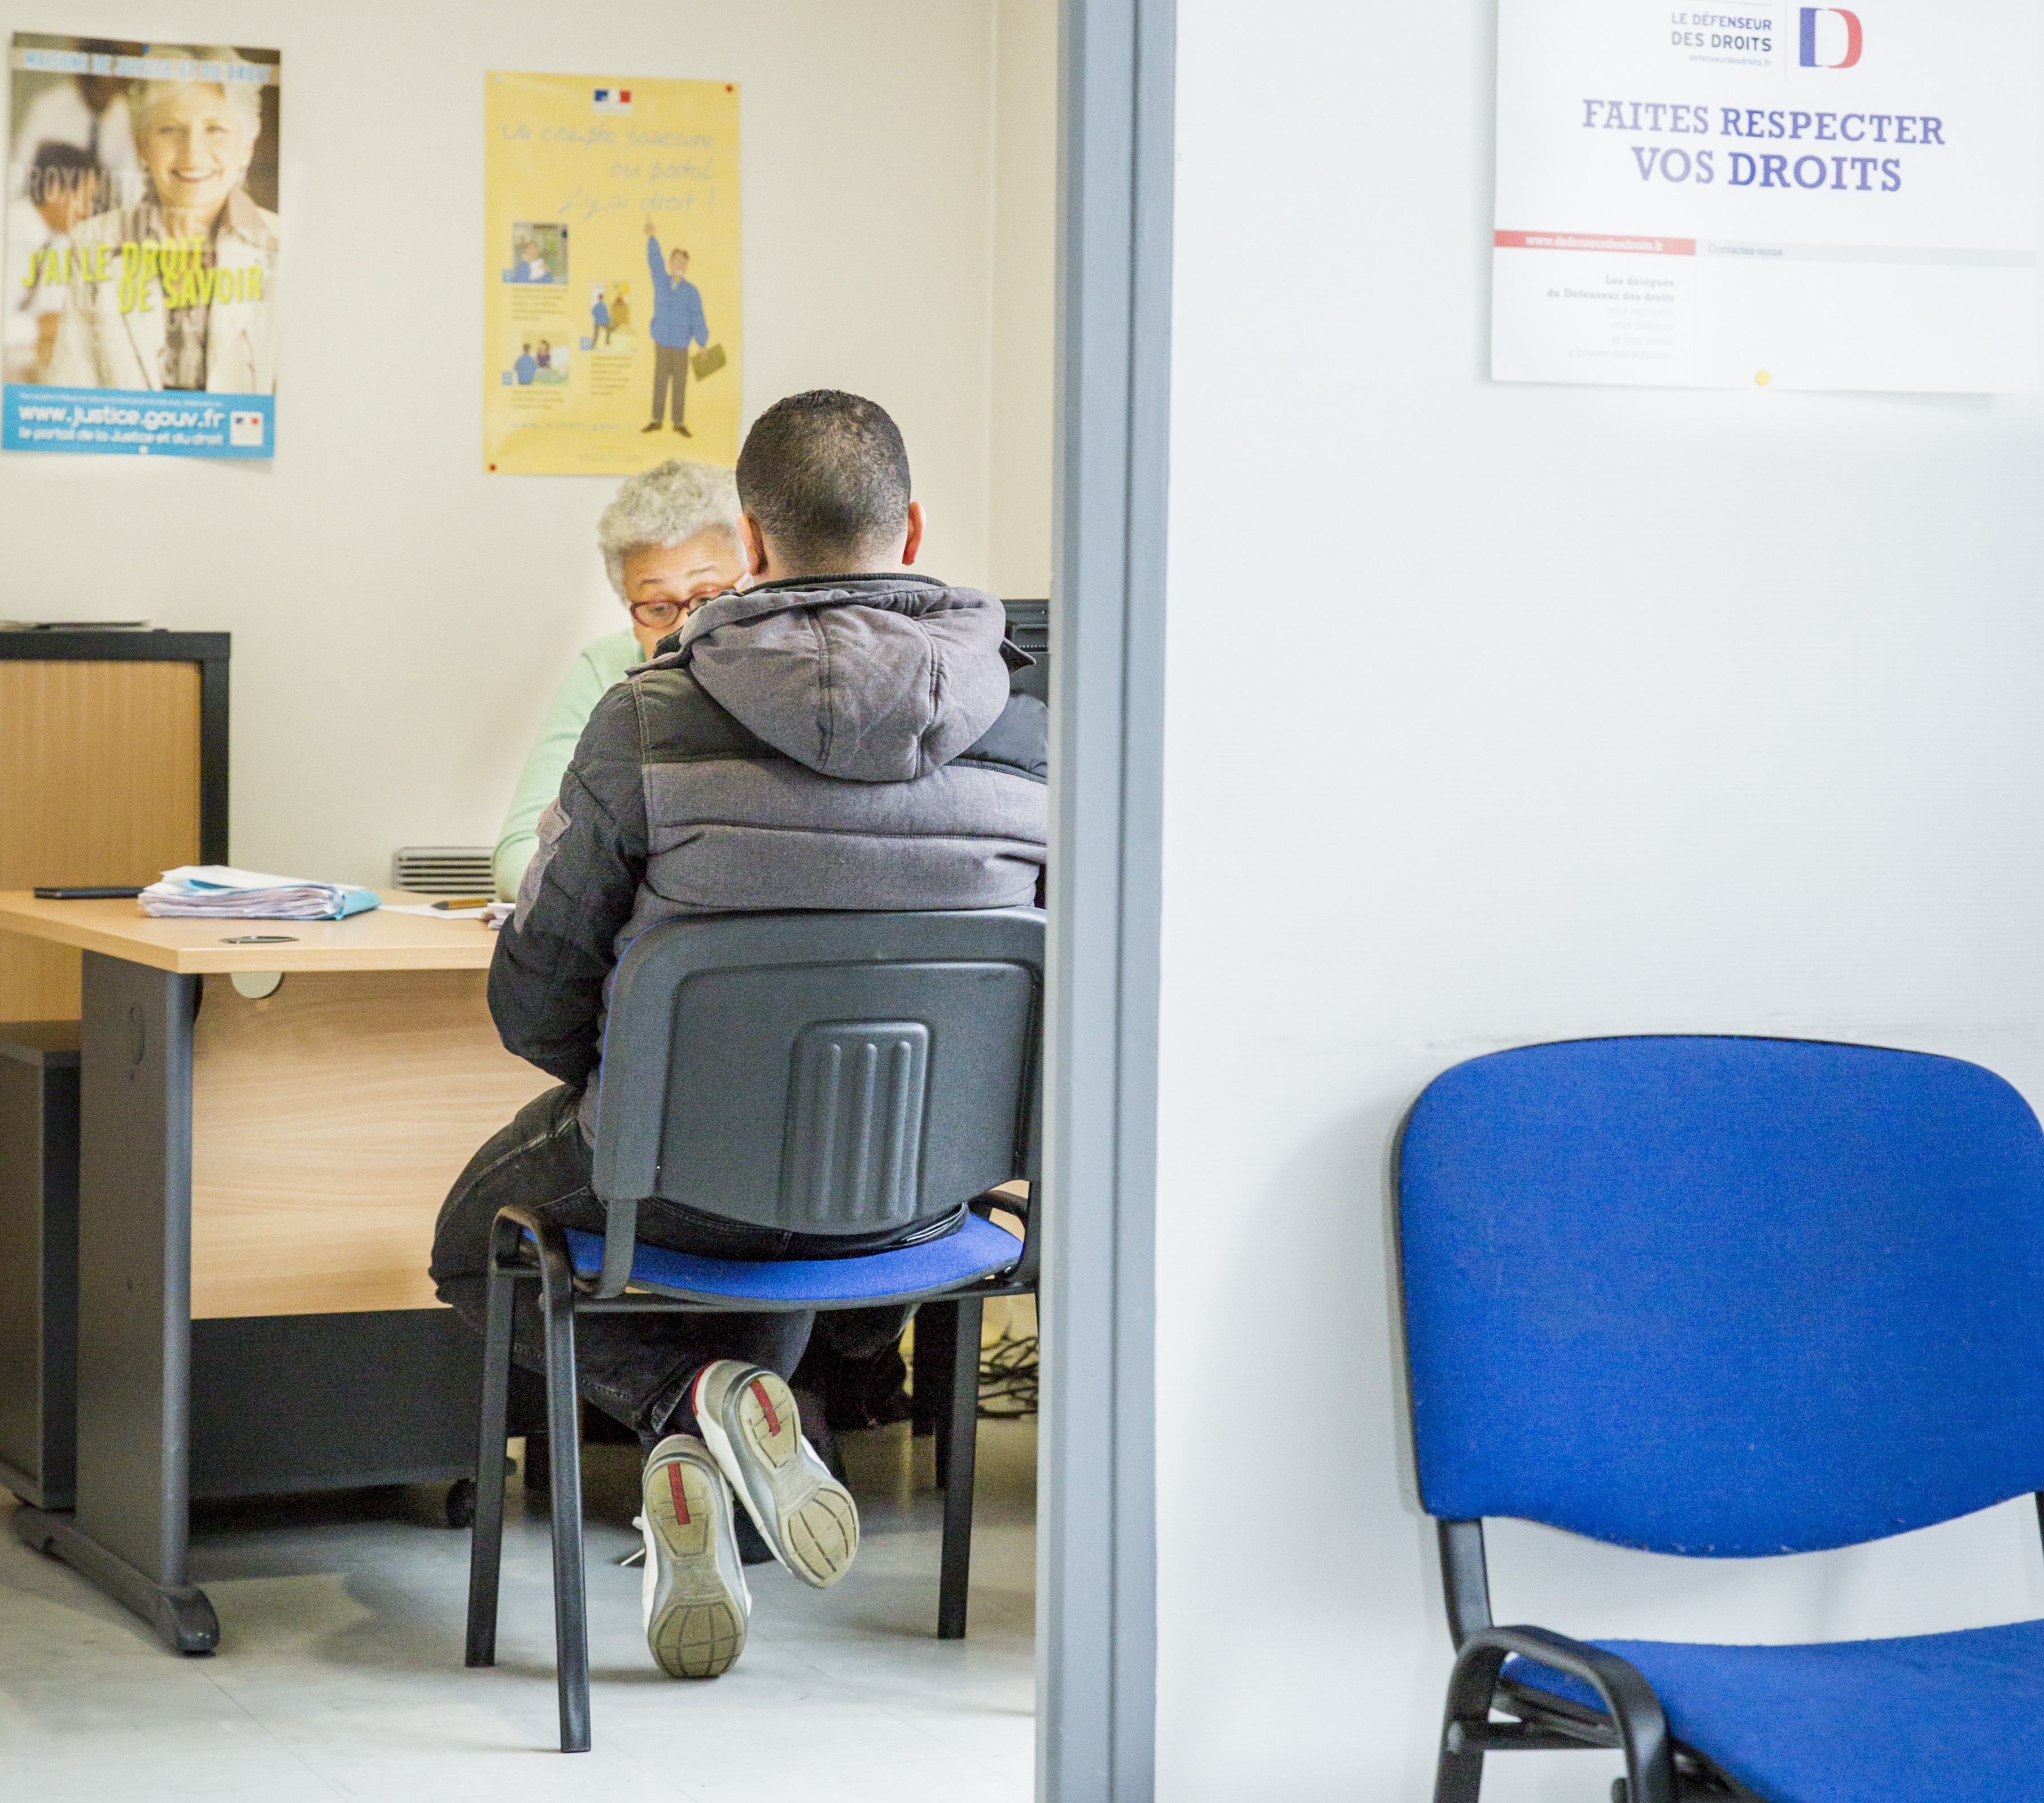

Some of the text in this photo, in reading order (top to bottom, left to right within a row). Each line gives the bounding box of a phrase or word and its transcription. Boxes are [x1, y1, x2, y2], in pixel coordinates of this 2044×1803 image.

[1671, 12, 1772, 30] LE DÉFENSEUR
[1671, 31, 1772, 52] DES DROITS
[1582, 99, 1946, 146] FAITES RESPECTER
[1631, 146, 1902, 193] VOS DROITS
[22, 235, 206, 288] J'AI LE DROIT
[119, 266, 263, 313] DE SAVOIR
[1623, 291, 1640, 300] des
[1644, 292, 1674, 302] droits
[19, 405, 225, 431] www.justice.gouv.fr
